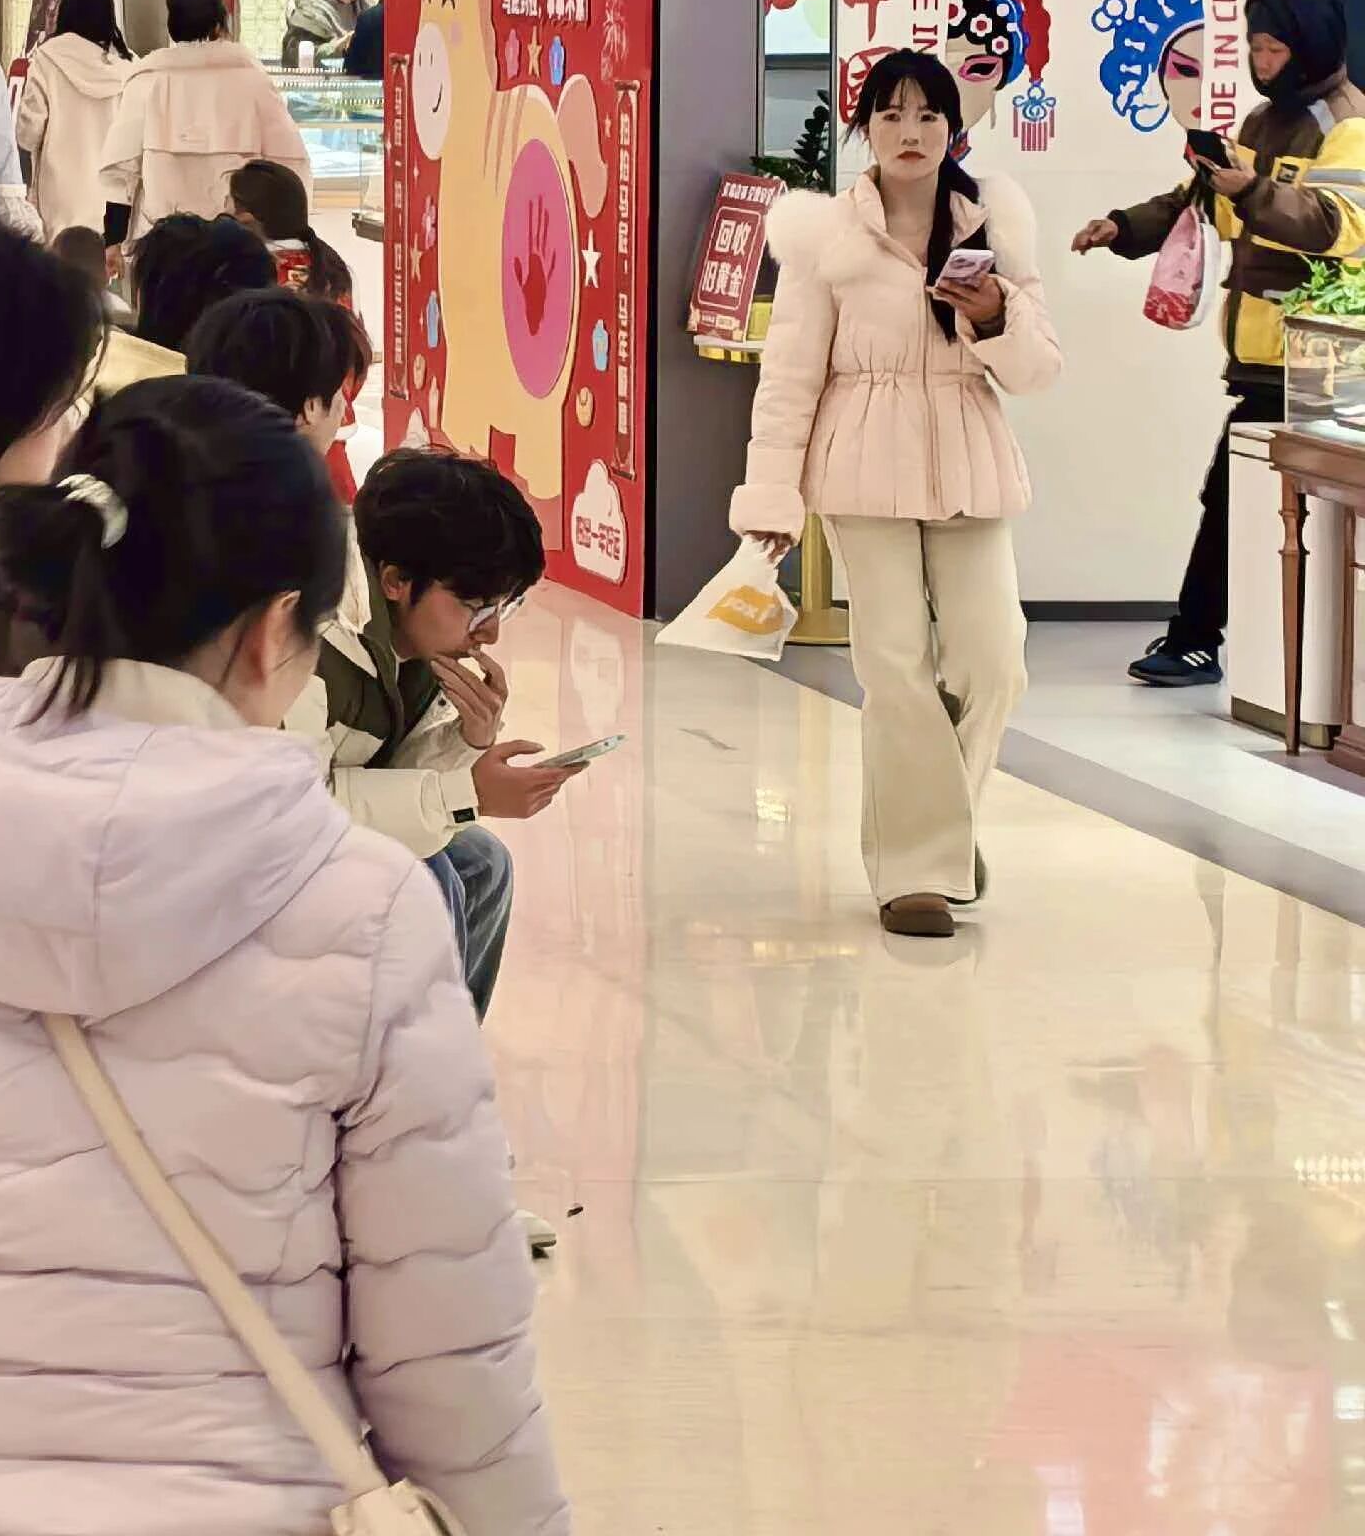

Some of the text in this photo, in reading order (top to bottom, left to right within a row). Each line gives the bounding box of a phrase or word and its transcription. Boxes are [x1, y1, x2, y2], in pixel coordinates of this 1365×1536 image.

[1214, 35, 1239, 69] IN
[1210, 82, 1237, 139] ADE
[714, 219, 751, 256] 回收
[701, 260, 743, 298] 旧黄金
